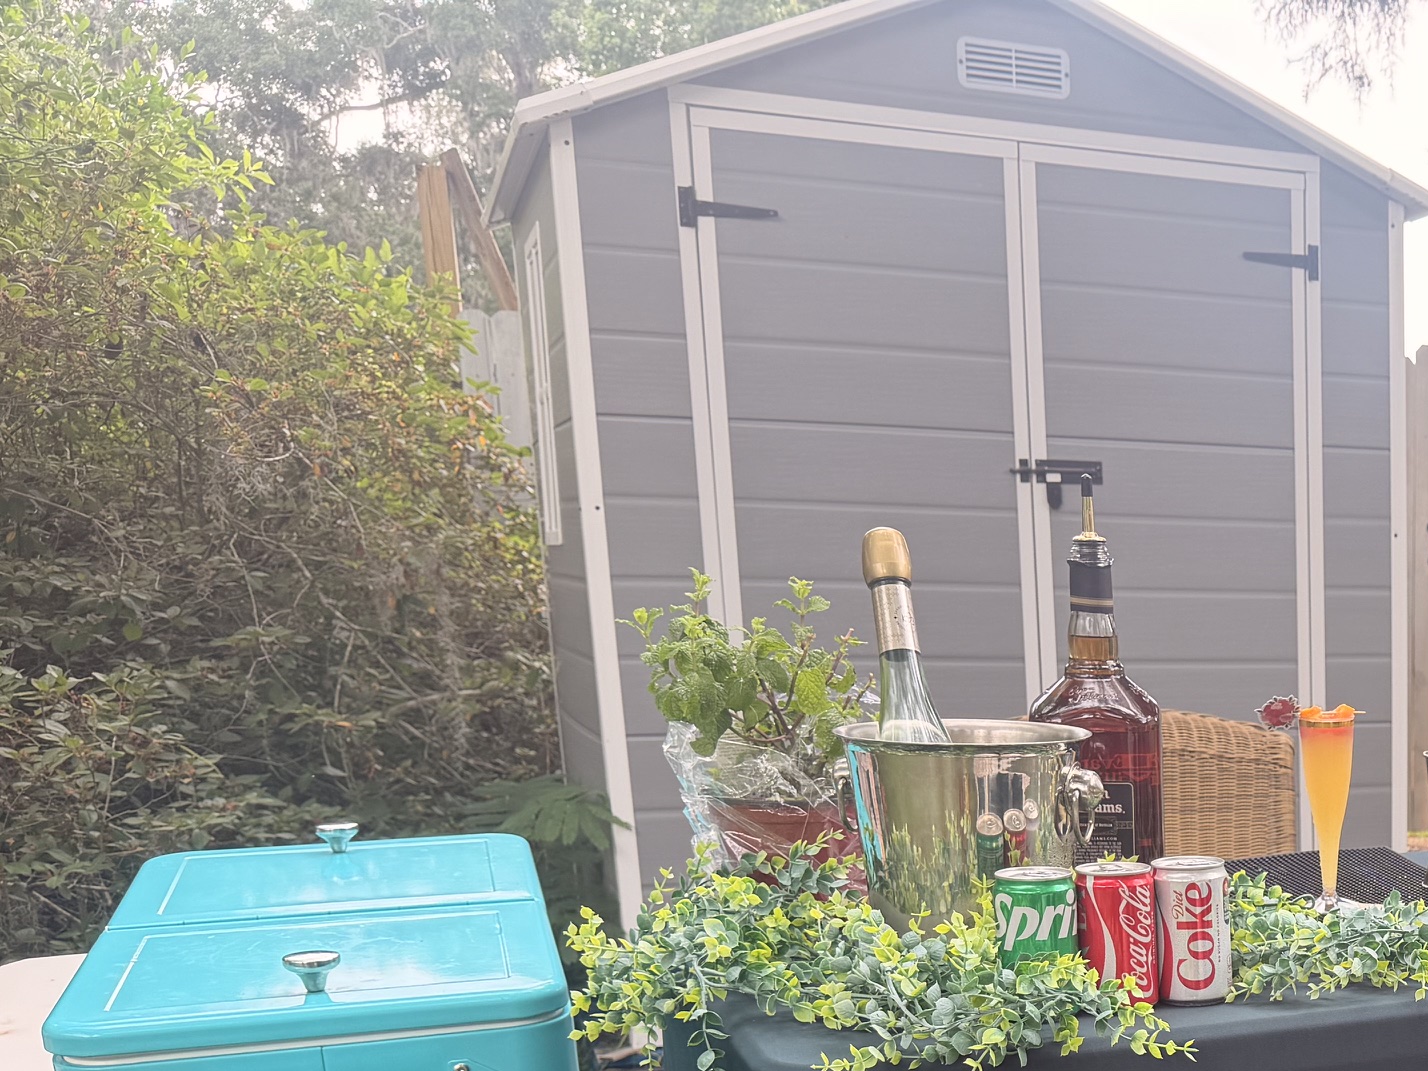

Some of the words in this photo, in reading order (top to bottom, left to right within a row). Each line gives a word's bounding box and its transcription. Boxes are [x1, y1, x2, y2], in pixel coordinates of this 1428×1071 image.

[1119, 880, 1153, 998] Coca-Cola
[1172, 890, 1184, 919] Diet
[1176, 882, 1216, 990] Coke
